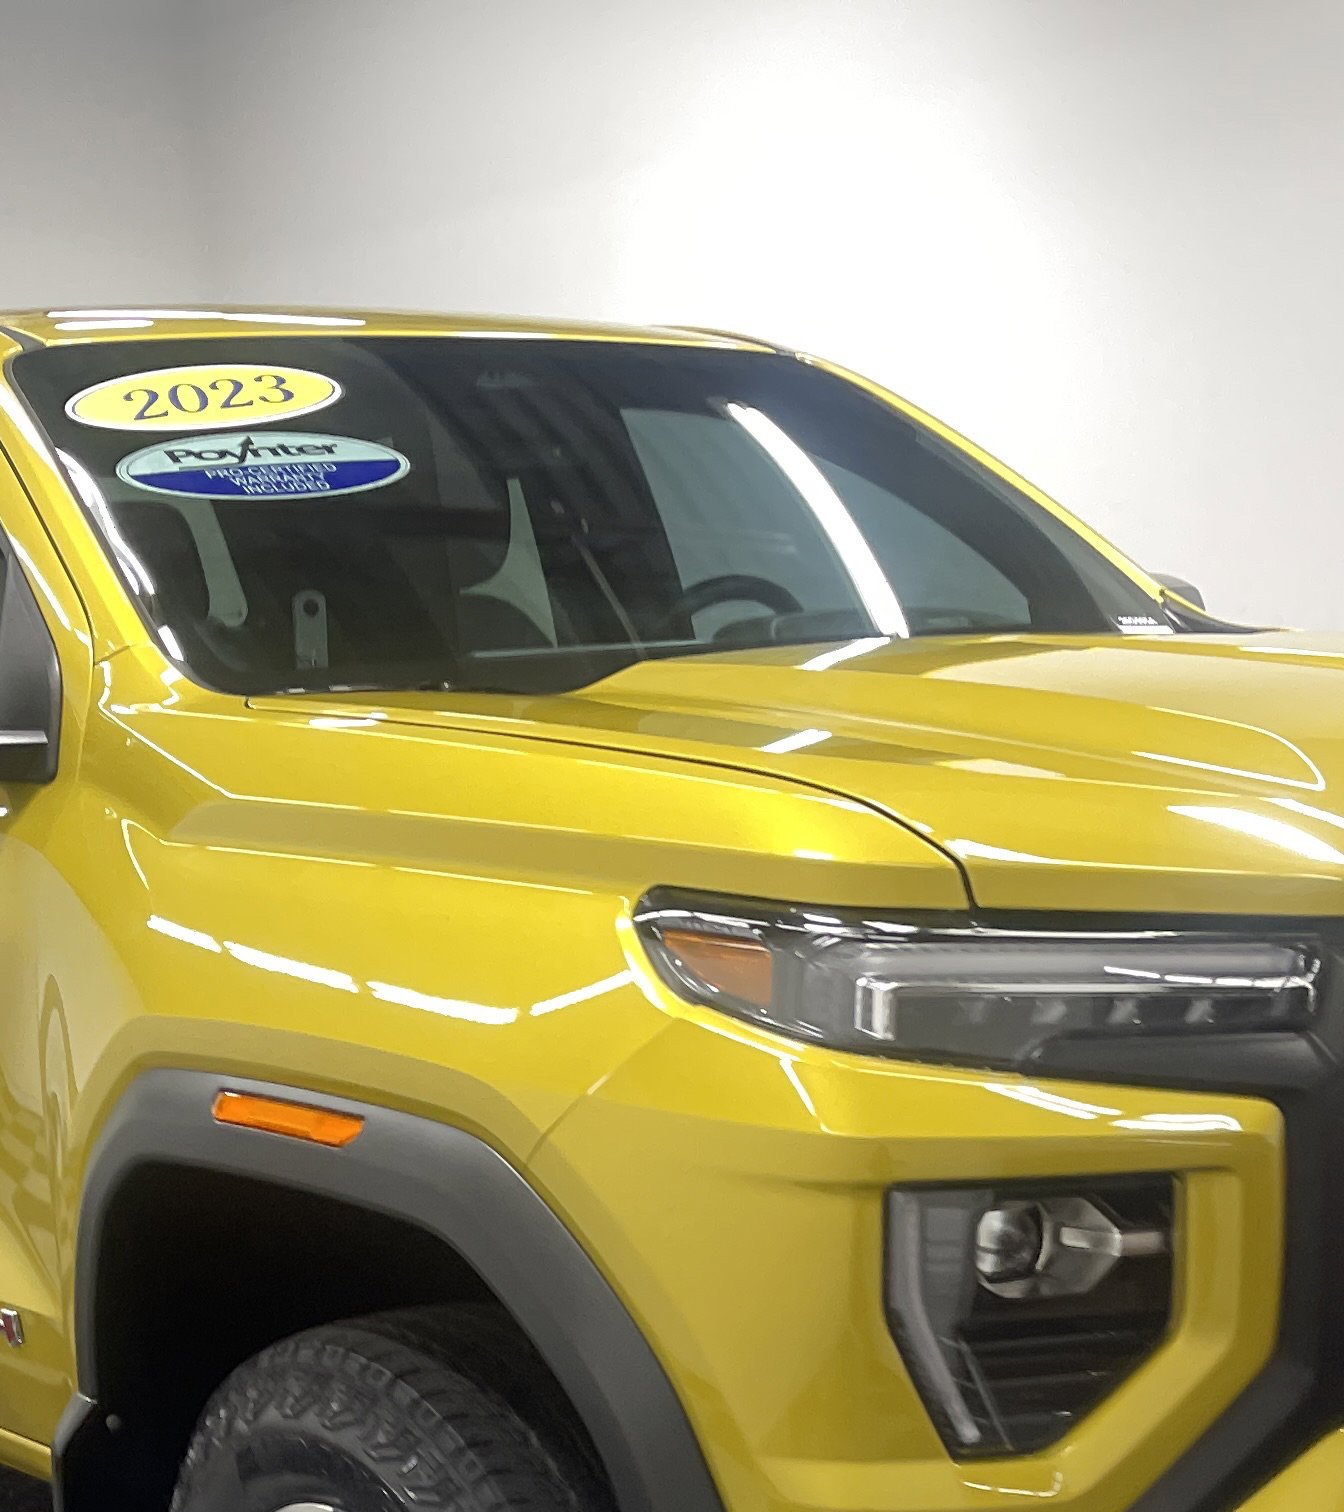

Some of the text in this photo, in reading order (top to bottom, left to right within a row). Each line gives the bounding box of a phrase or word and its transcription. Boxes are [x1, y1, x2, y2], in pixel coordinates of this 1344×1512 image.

[122, 374, 295, 421] 2023
[163, 435, 338, 464] Poynter
[229, 471, 327, 487] WARRANTY
[242, 481, 331, 495] INCLUDED
